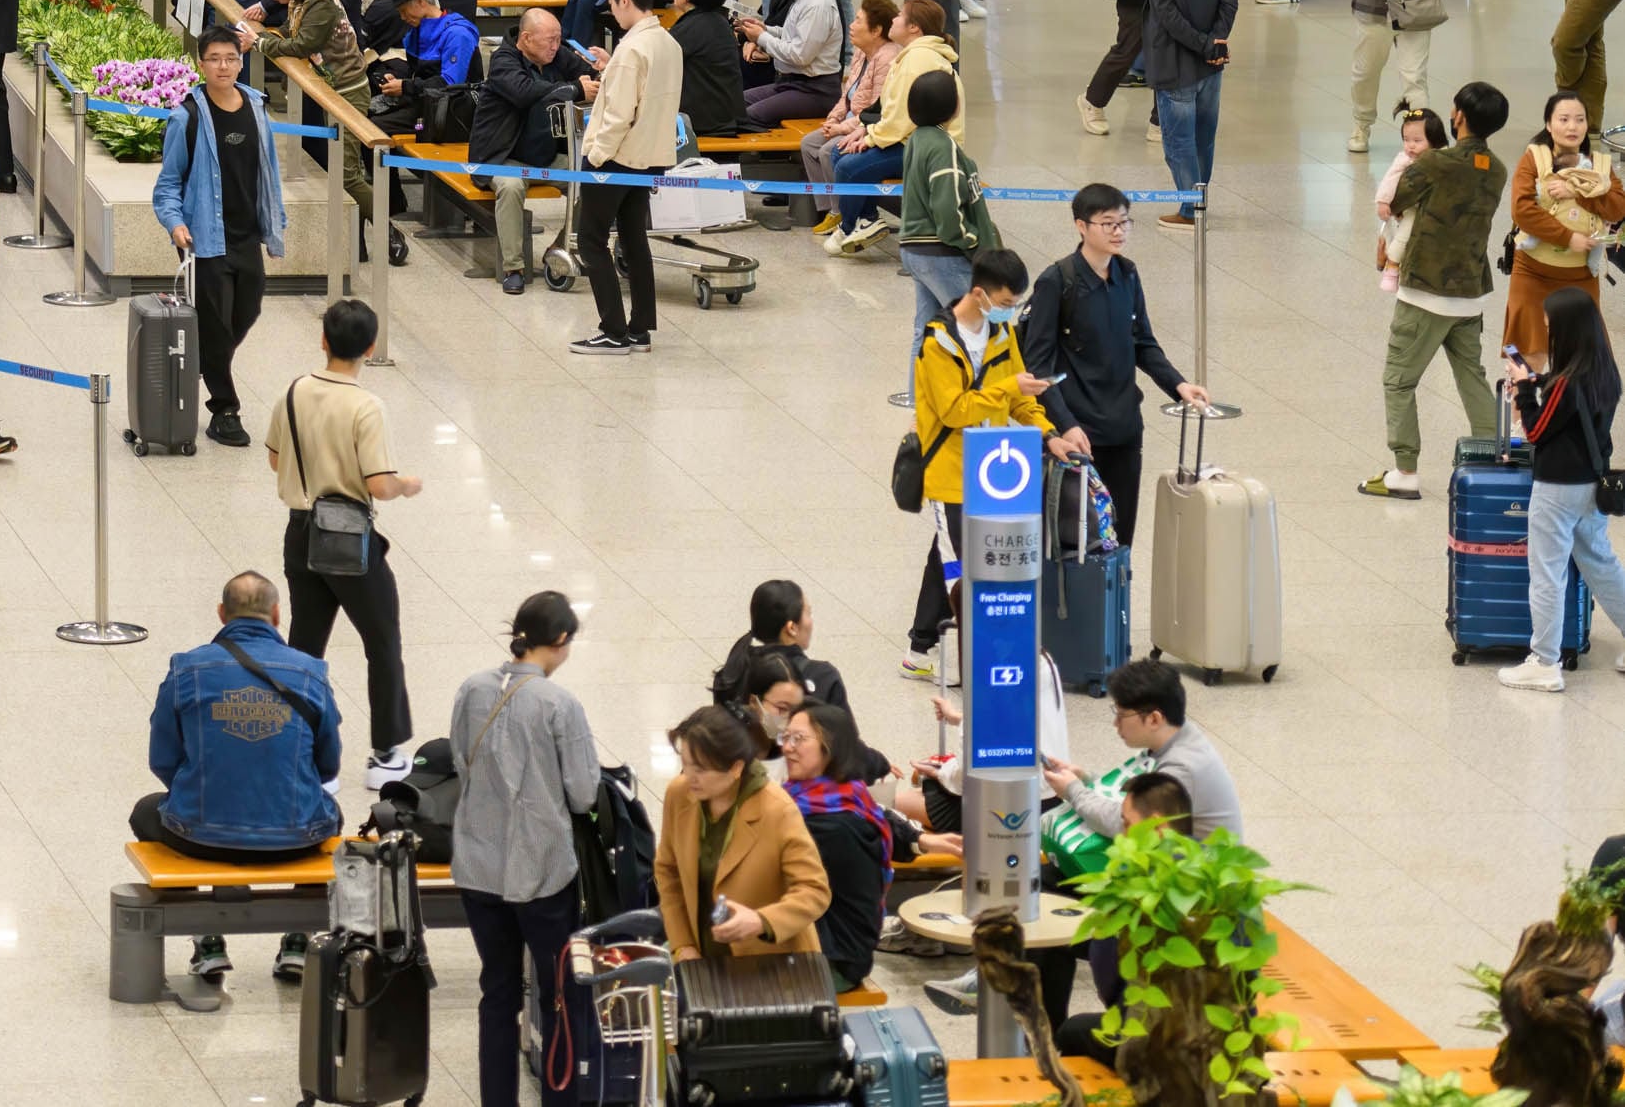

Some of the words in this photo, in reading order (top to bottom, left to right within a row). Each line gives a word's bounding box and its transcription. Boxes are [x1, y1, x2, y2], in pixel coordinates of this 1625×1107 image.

[653, 176, 700, 189] SECURITY
[20, 364, 55, 381] SECURITY
[980, 593, 996, 603] Free
[997, 592, 1032, 603] Charging
